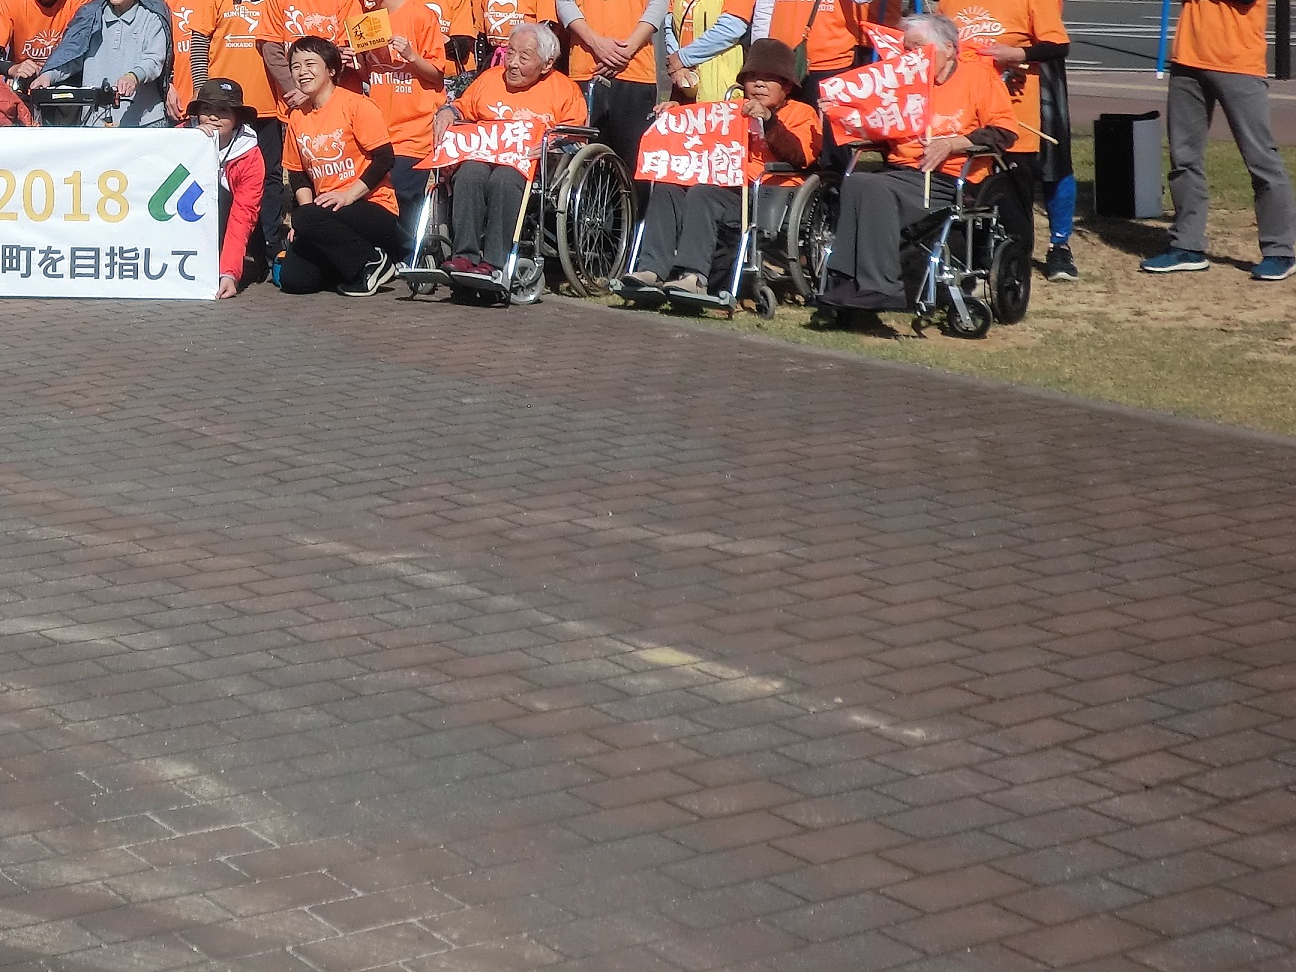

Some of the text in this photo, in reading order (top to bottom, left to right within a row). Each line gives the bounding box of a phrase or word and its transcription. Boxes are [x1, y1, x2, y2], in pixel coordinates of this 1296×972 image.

[370, 37, 385, 46] TOMO
[640, 140, 745, 185] 月明館
